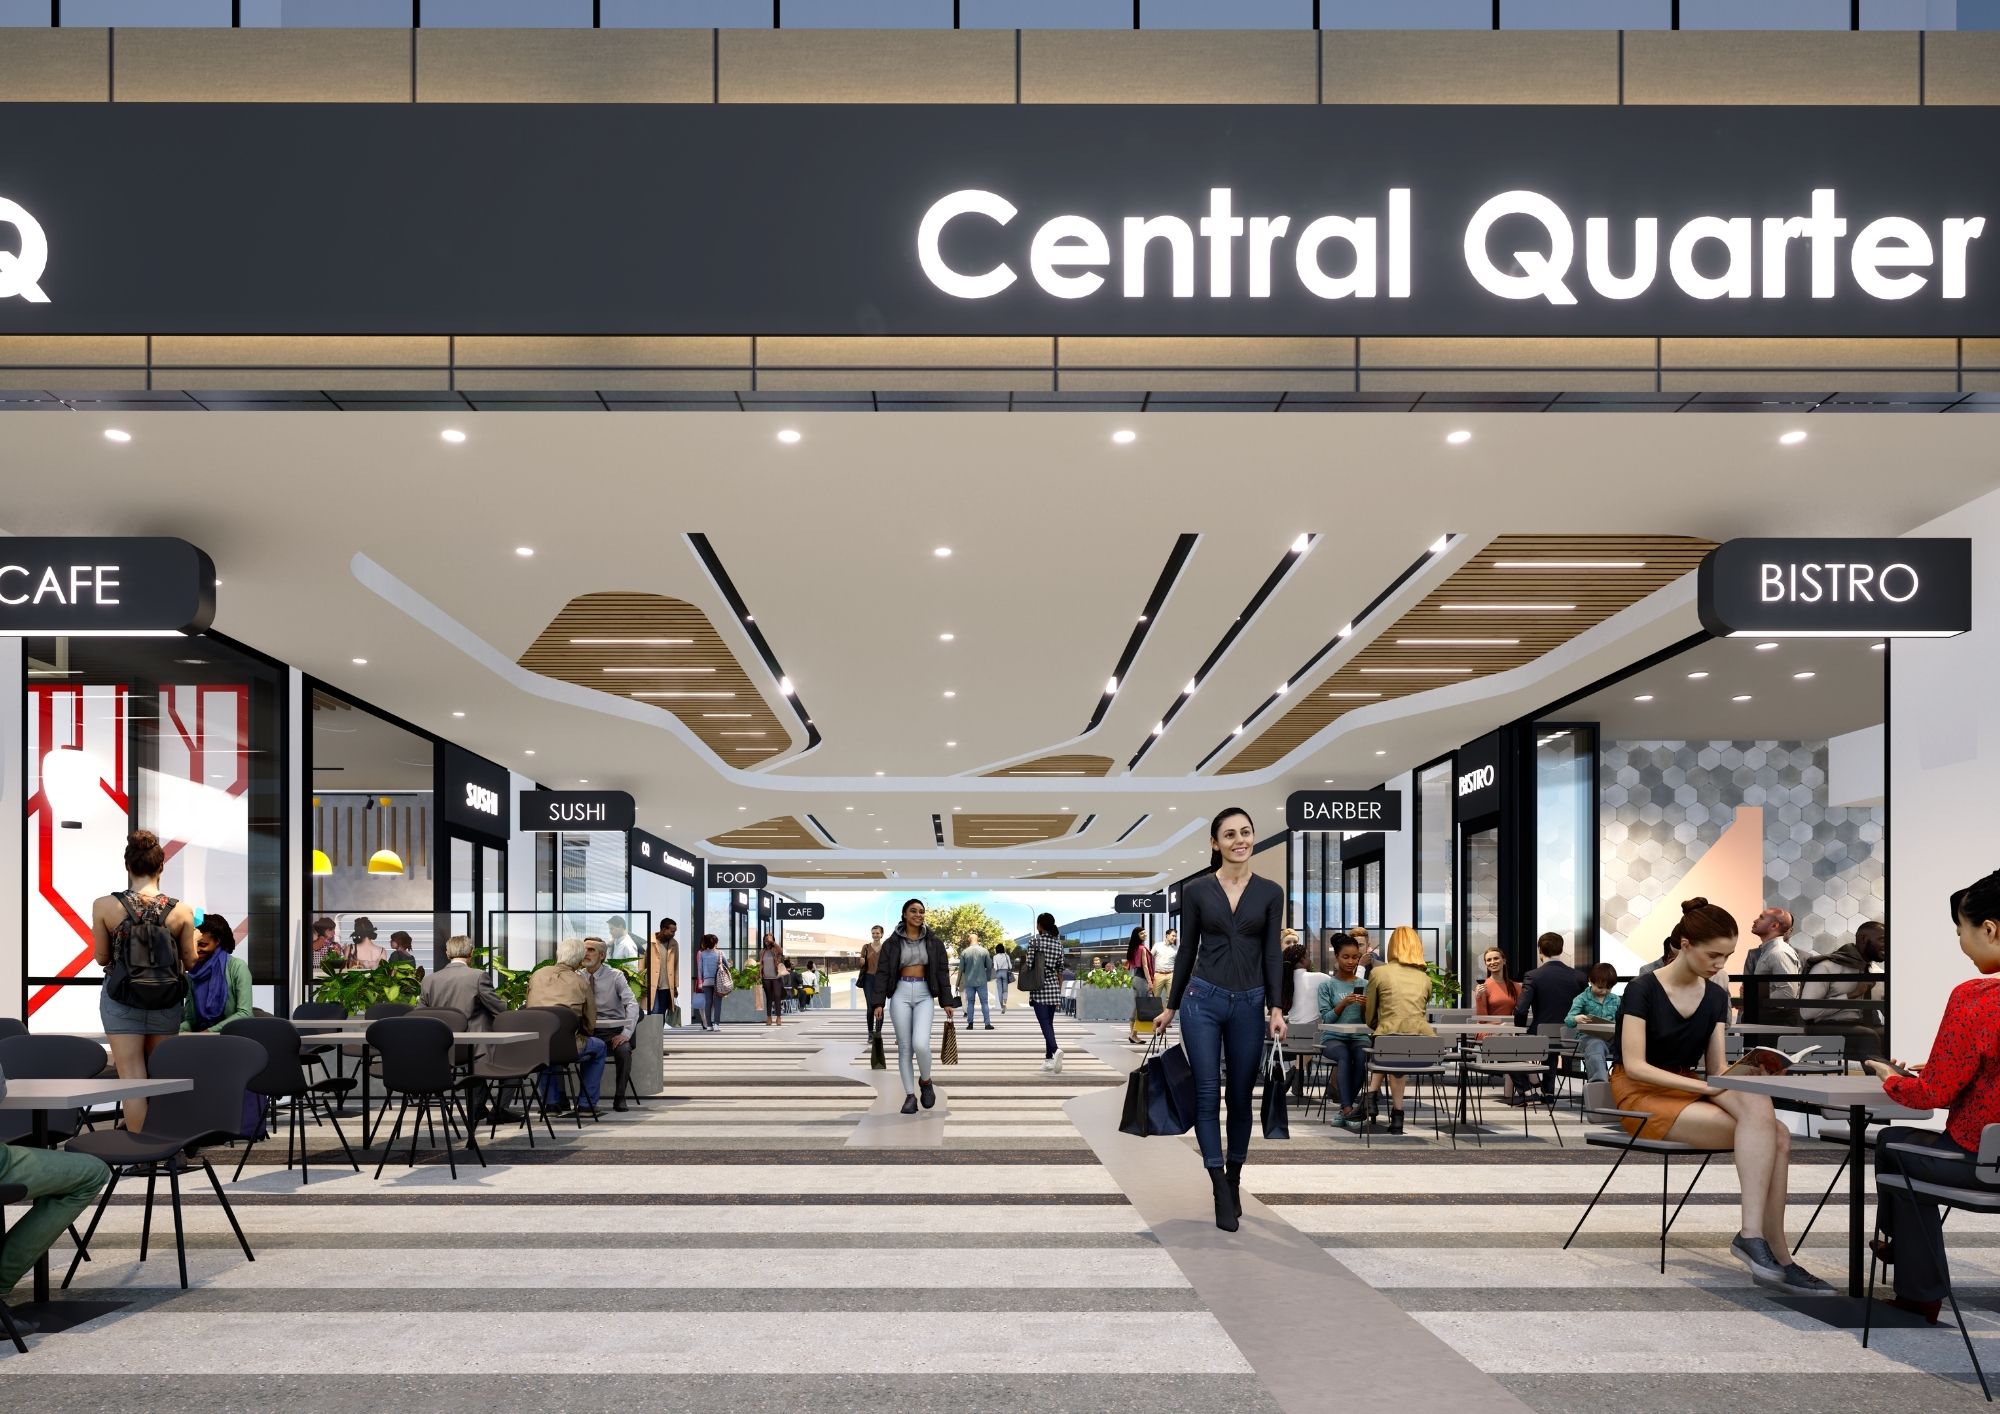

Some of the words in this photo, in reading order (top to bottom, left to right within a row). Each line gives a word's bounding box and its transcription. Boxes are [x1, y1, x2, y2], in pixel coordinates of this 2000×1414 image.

[918, 188, 1411, 300] Central
[1463, 189, 1986, 305] Quarter
[0, 565, 120, 605] CAFE
[1761, 563, 1920, 603] BISTRO
[1458, 764, 1495, 797] BISTRO
[465, 782, 499, 816] SUSHI
[548, 802, 606, 821] SUSHI
[1303, 801, 1383, 820] BARBER
[716, 871, 757, 884] FOOD
[787, 907, 813, 919] CAFE
[1132, 898, 1152, 909] KFC
